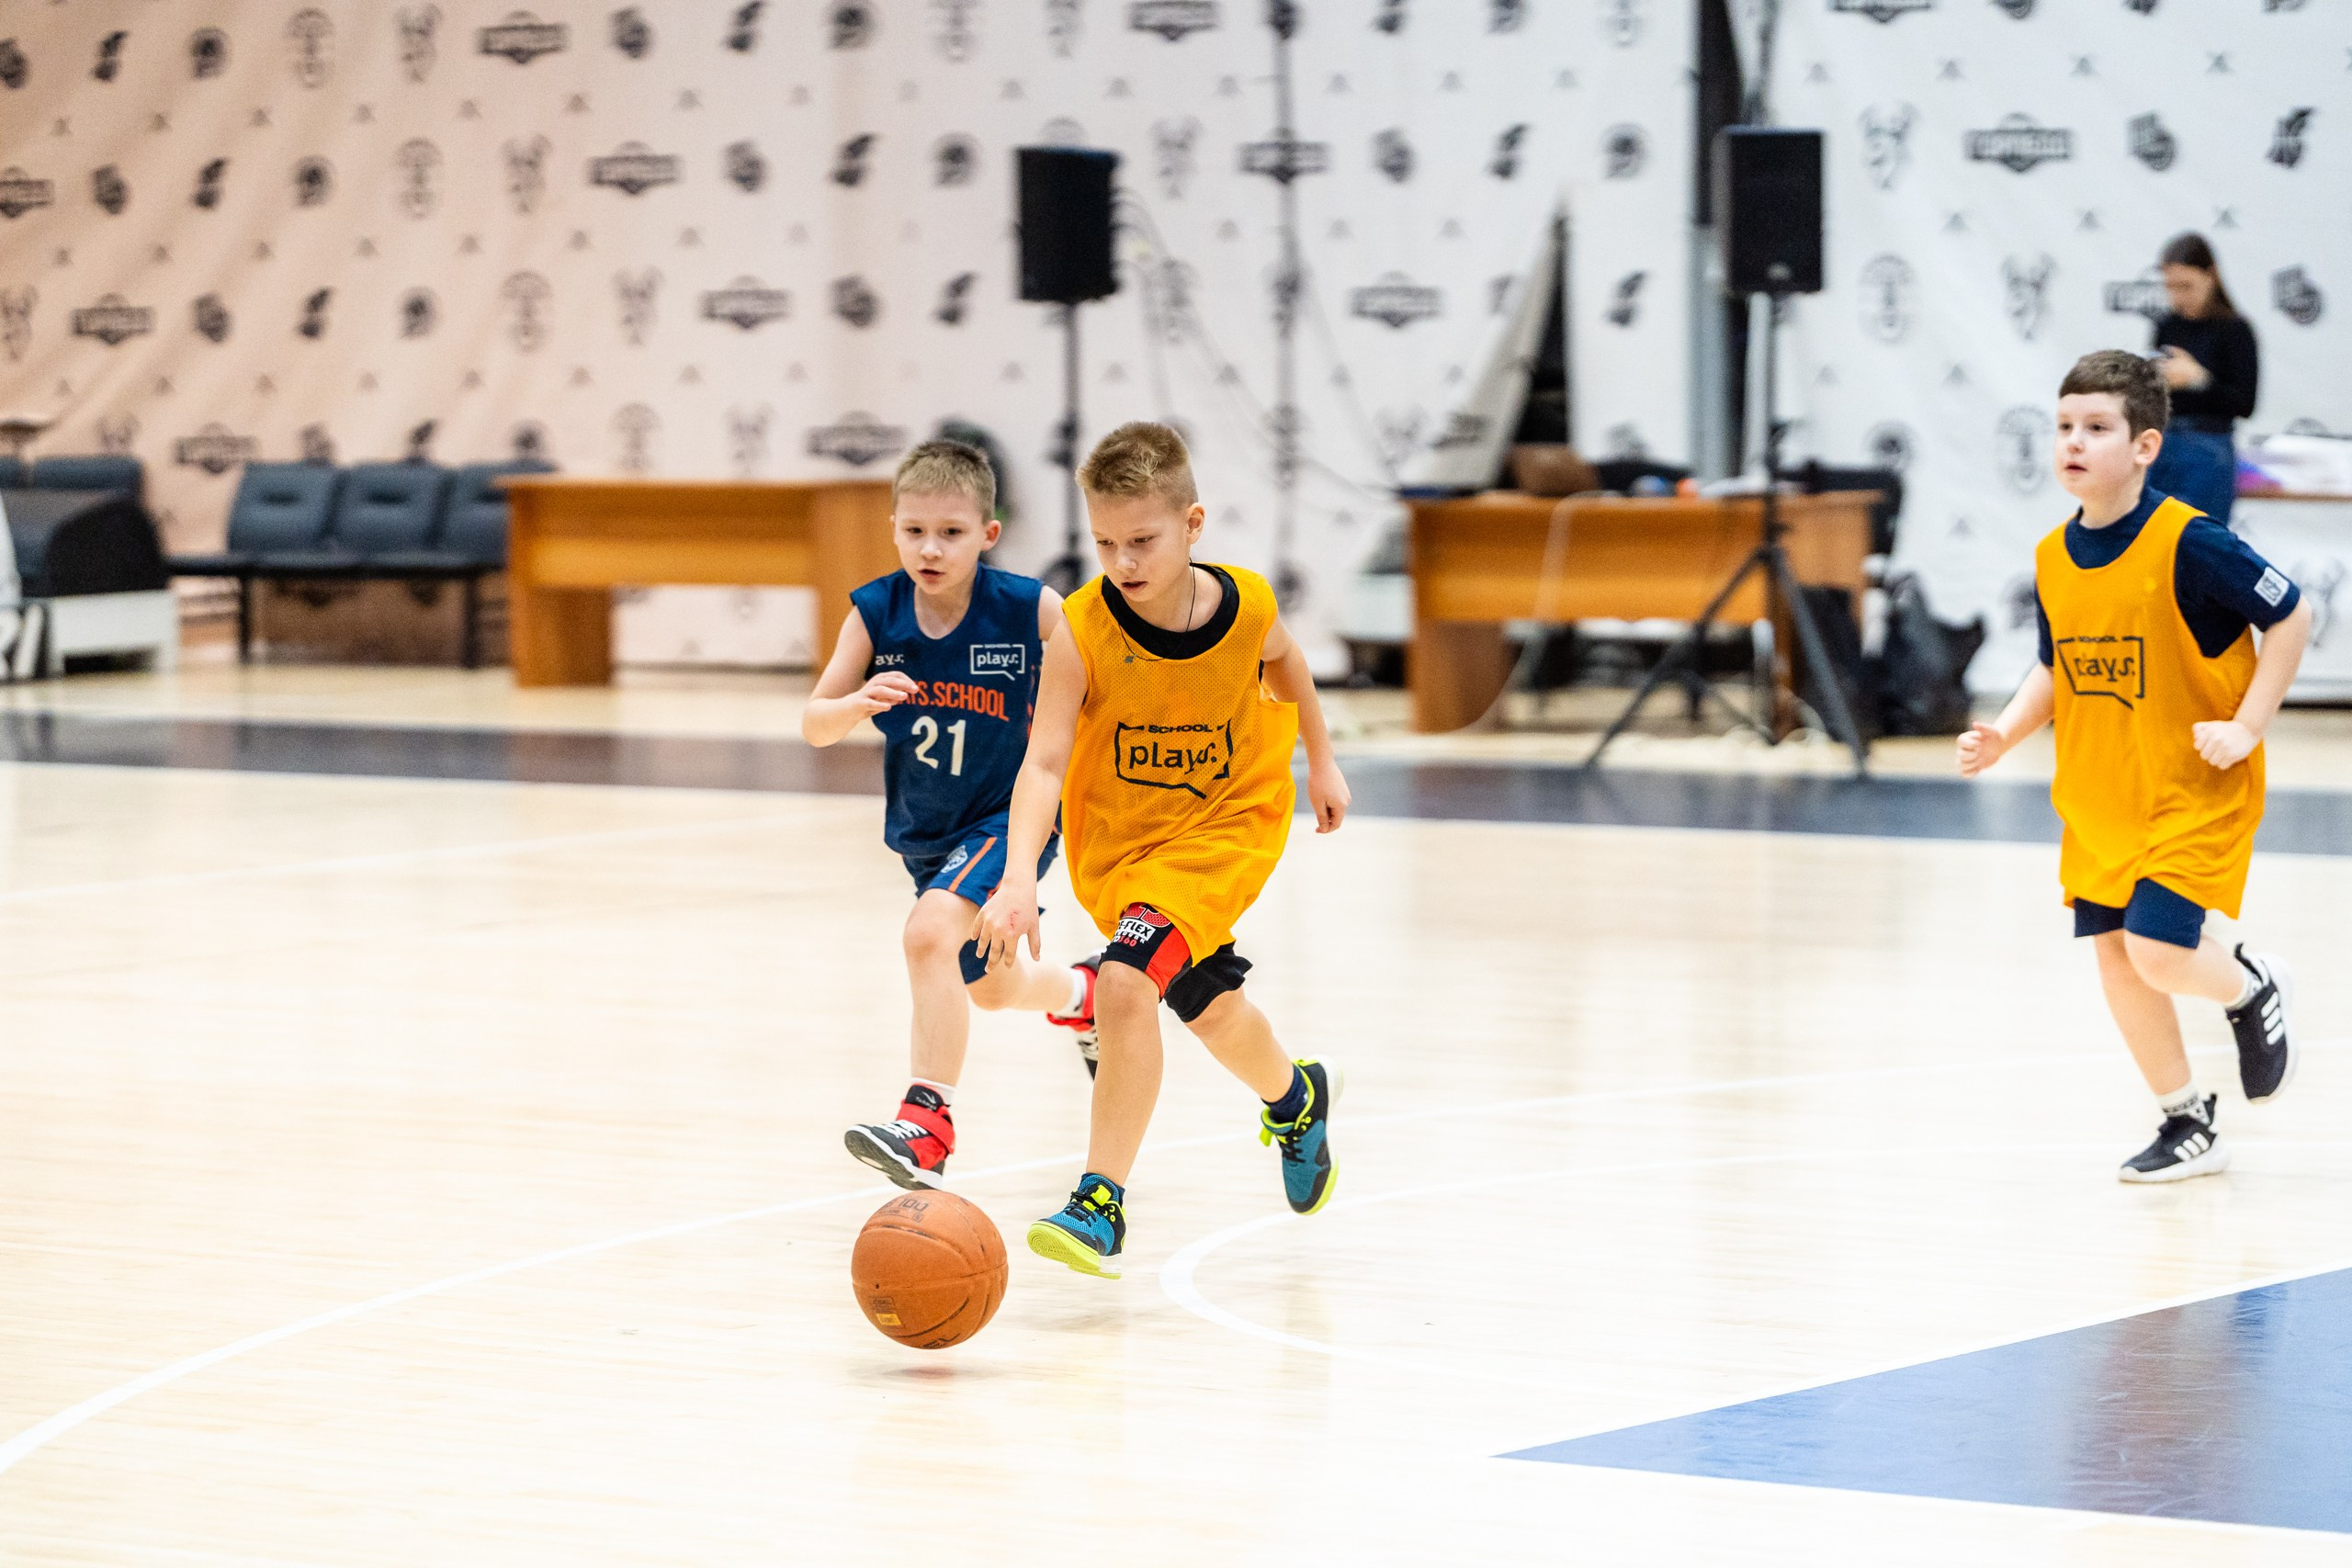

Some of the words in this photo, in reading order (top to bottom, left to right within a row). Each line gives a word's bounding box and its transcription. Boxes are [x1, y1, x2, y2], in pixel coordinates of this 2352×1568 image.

[876, 653, 905, 666] ays.
[899, 681, 1010, 722] S.SCHOOL
[1148, 724, 1213, 734] SCHOOL
[911, 716, 967, 776] 21
